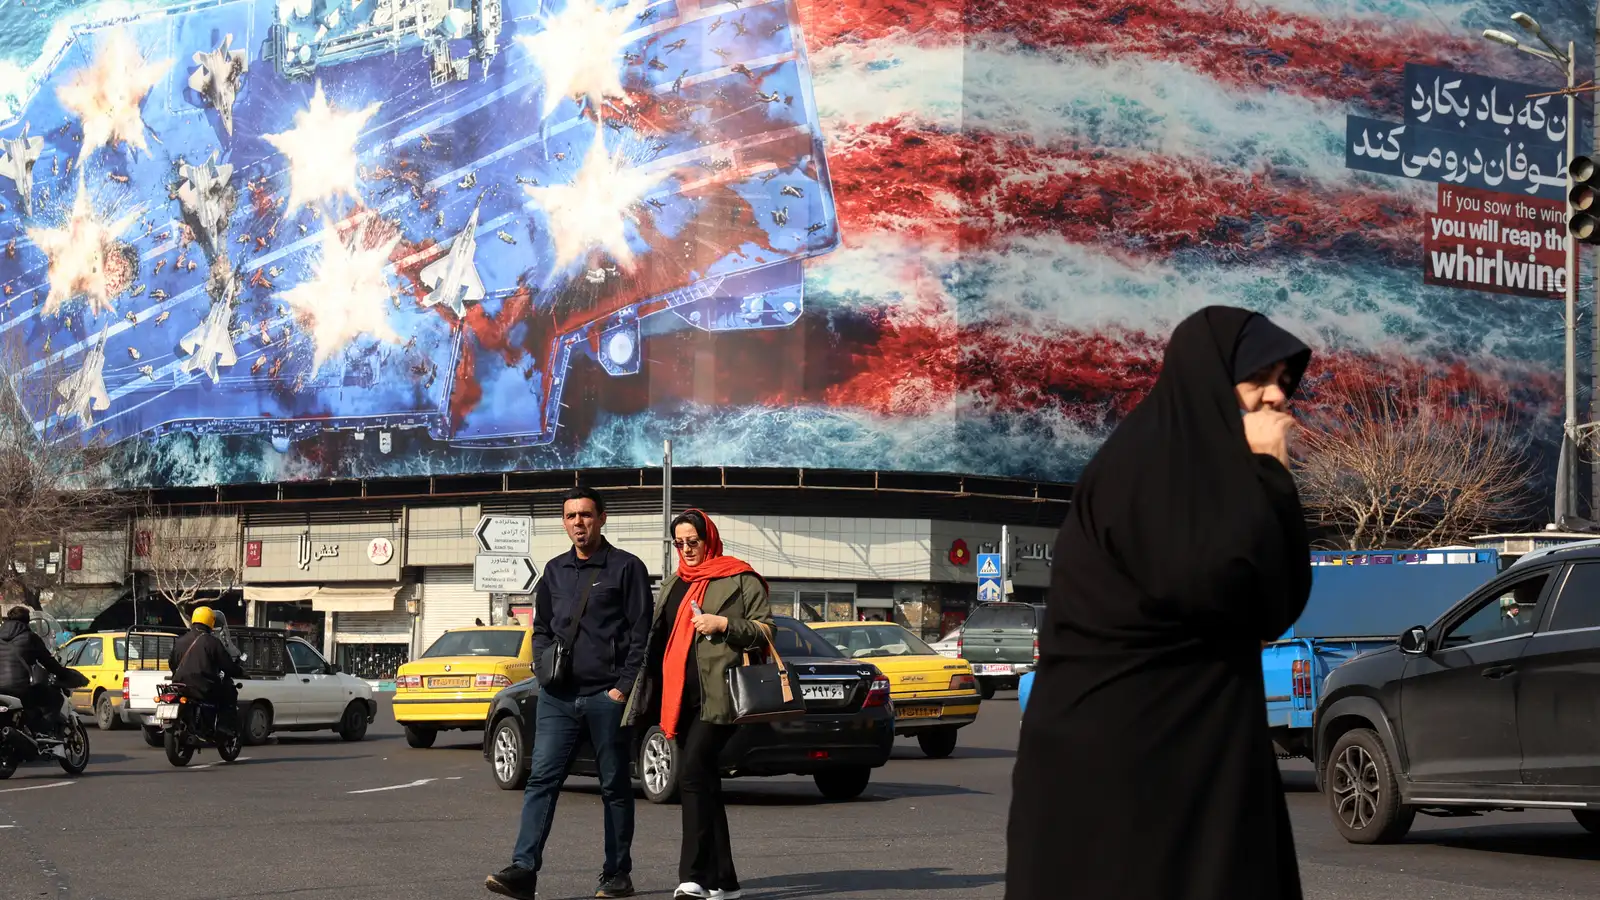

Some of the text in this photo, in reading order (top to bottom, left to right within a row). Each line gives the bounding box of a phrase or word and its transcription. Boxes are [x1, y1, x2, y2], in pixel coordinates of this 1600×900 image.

[1411, 76, 1470, 129] بکارد
[1476, 85, 1515, 136] باد
[1442, 190, 1453, 207] If
[1456, 196, 1480, 213] you
[1484, 200, 1511, 216] sow
[1515, 201, 1537, 219] the
[1431, 217, 1466, 240] you
[1469, 219, 1498, 242] will
[1502, 227, 1542, 253] reap
[314, 544, 340, 561] کفش
